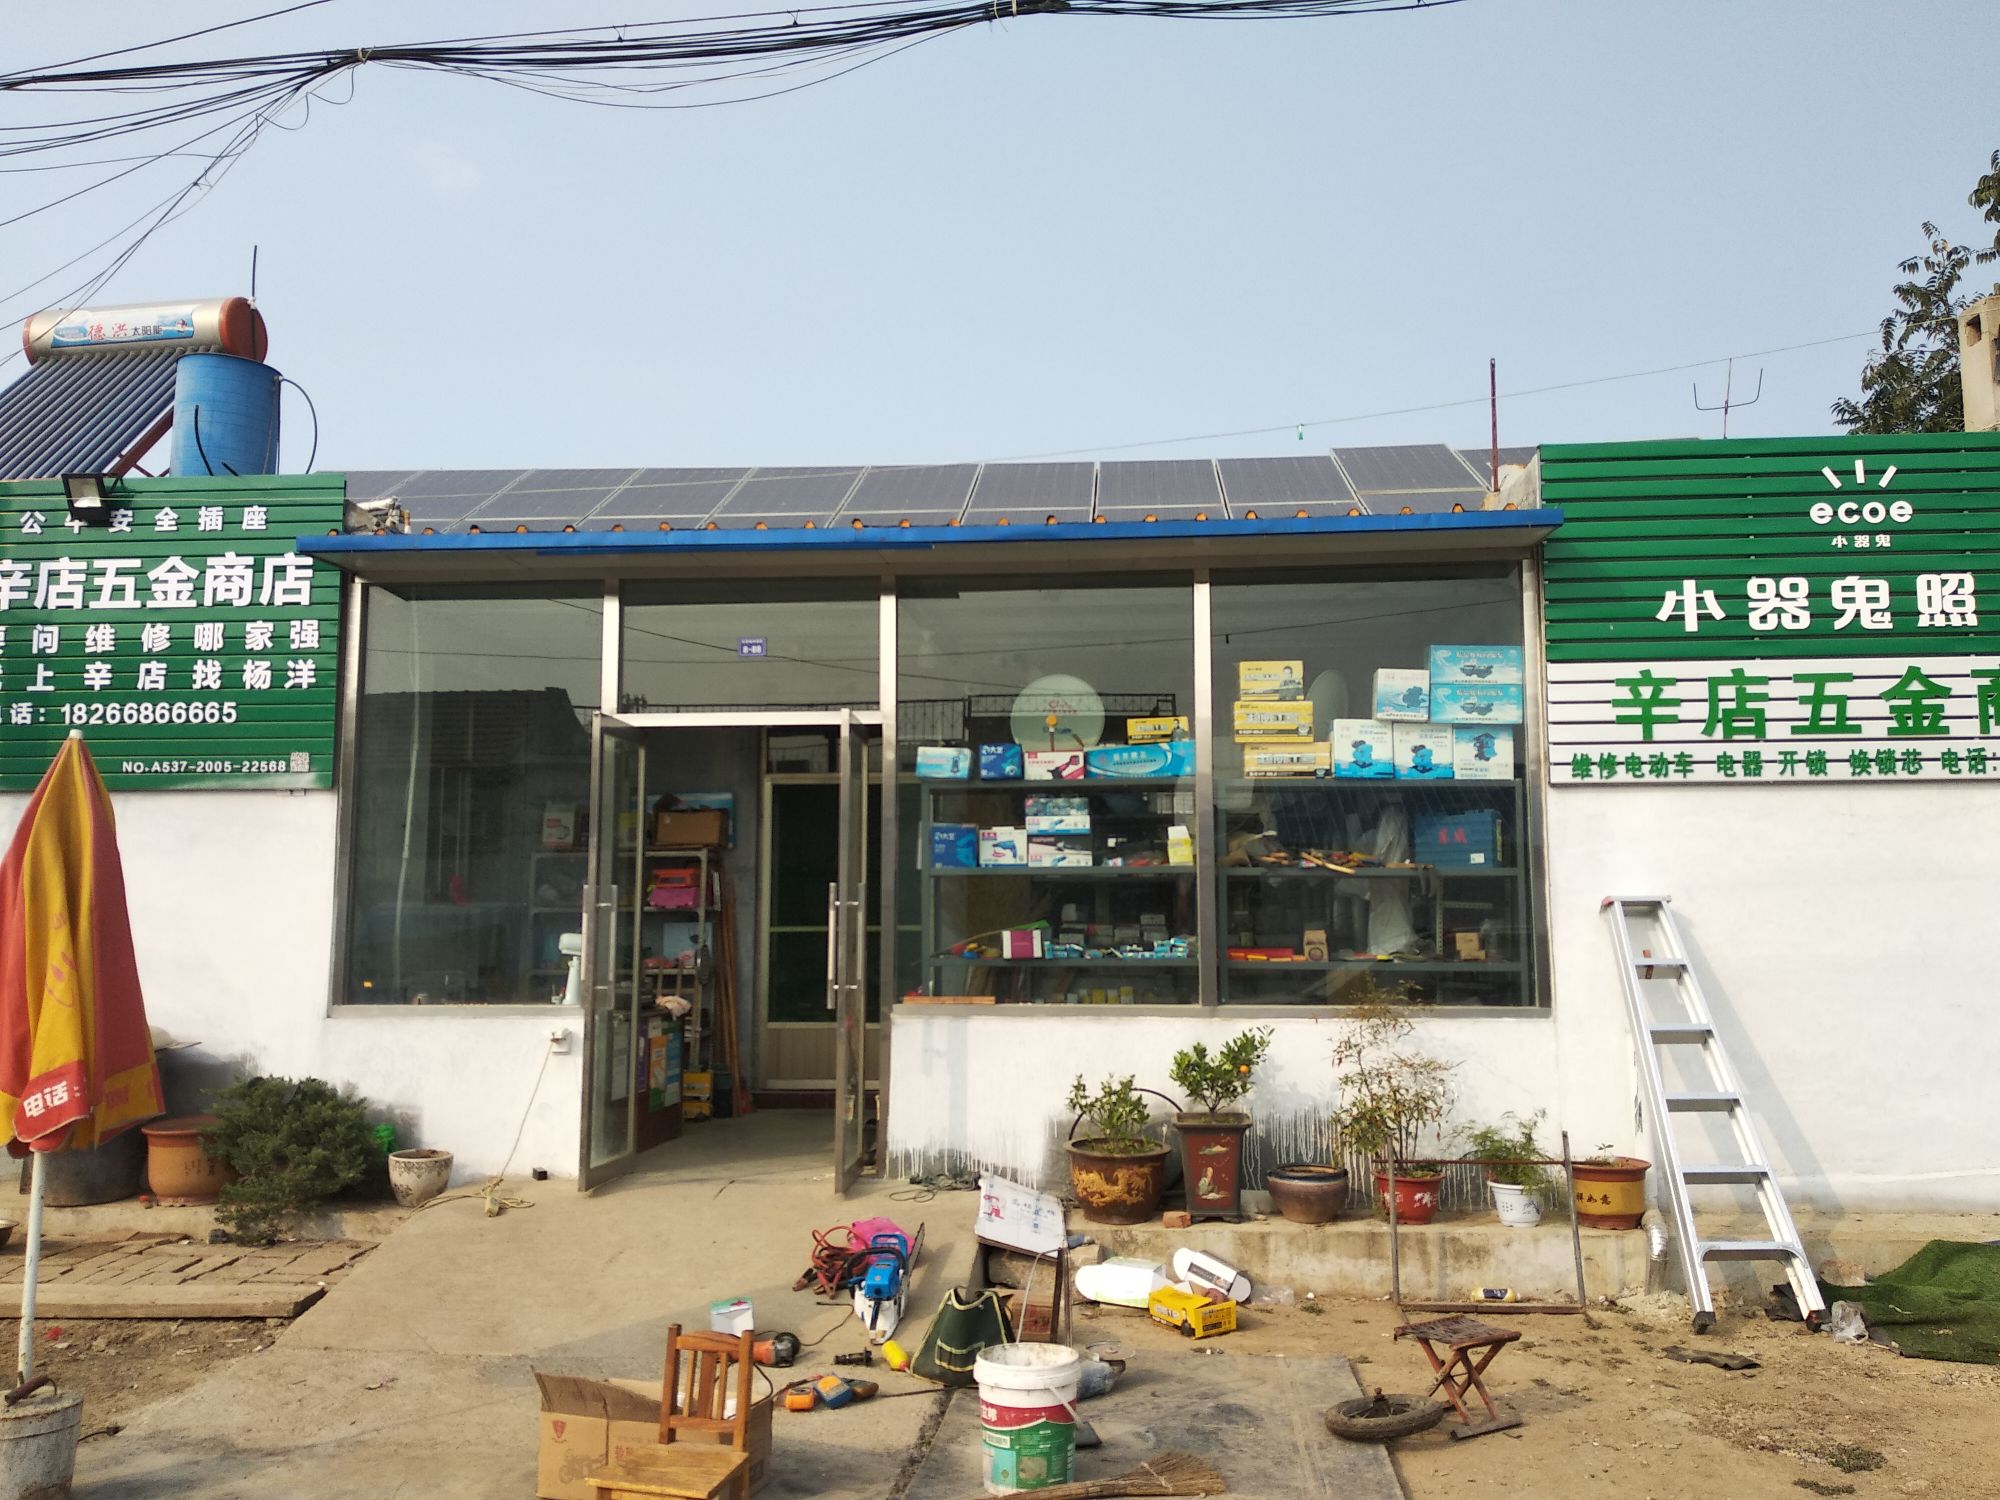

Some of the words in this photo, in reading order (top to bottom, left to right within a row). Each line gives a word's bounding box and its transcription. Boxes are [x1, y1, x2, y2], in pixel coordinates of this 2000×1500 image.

[1809, 500, 1913, 525] ecoe
[1831, 533, 1891, 549] 小器鬼
[0, 551, 314, 611] 辛店五金商店
[1655, 573, 1979, 633] 小器鬼照
[0, 619, 320, 654] 问维修哪家强
[0, 659, 317, 692] 上辛店找杨洋
[0, 701, 238, 726] 话：18266866665
[1571, 751, 1694, 780] 维修电动车
[1716, 750, 1763, 778] 电器
[1777, 749, 1828, 776] 开锁
